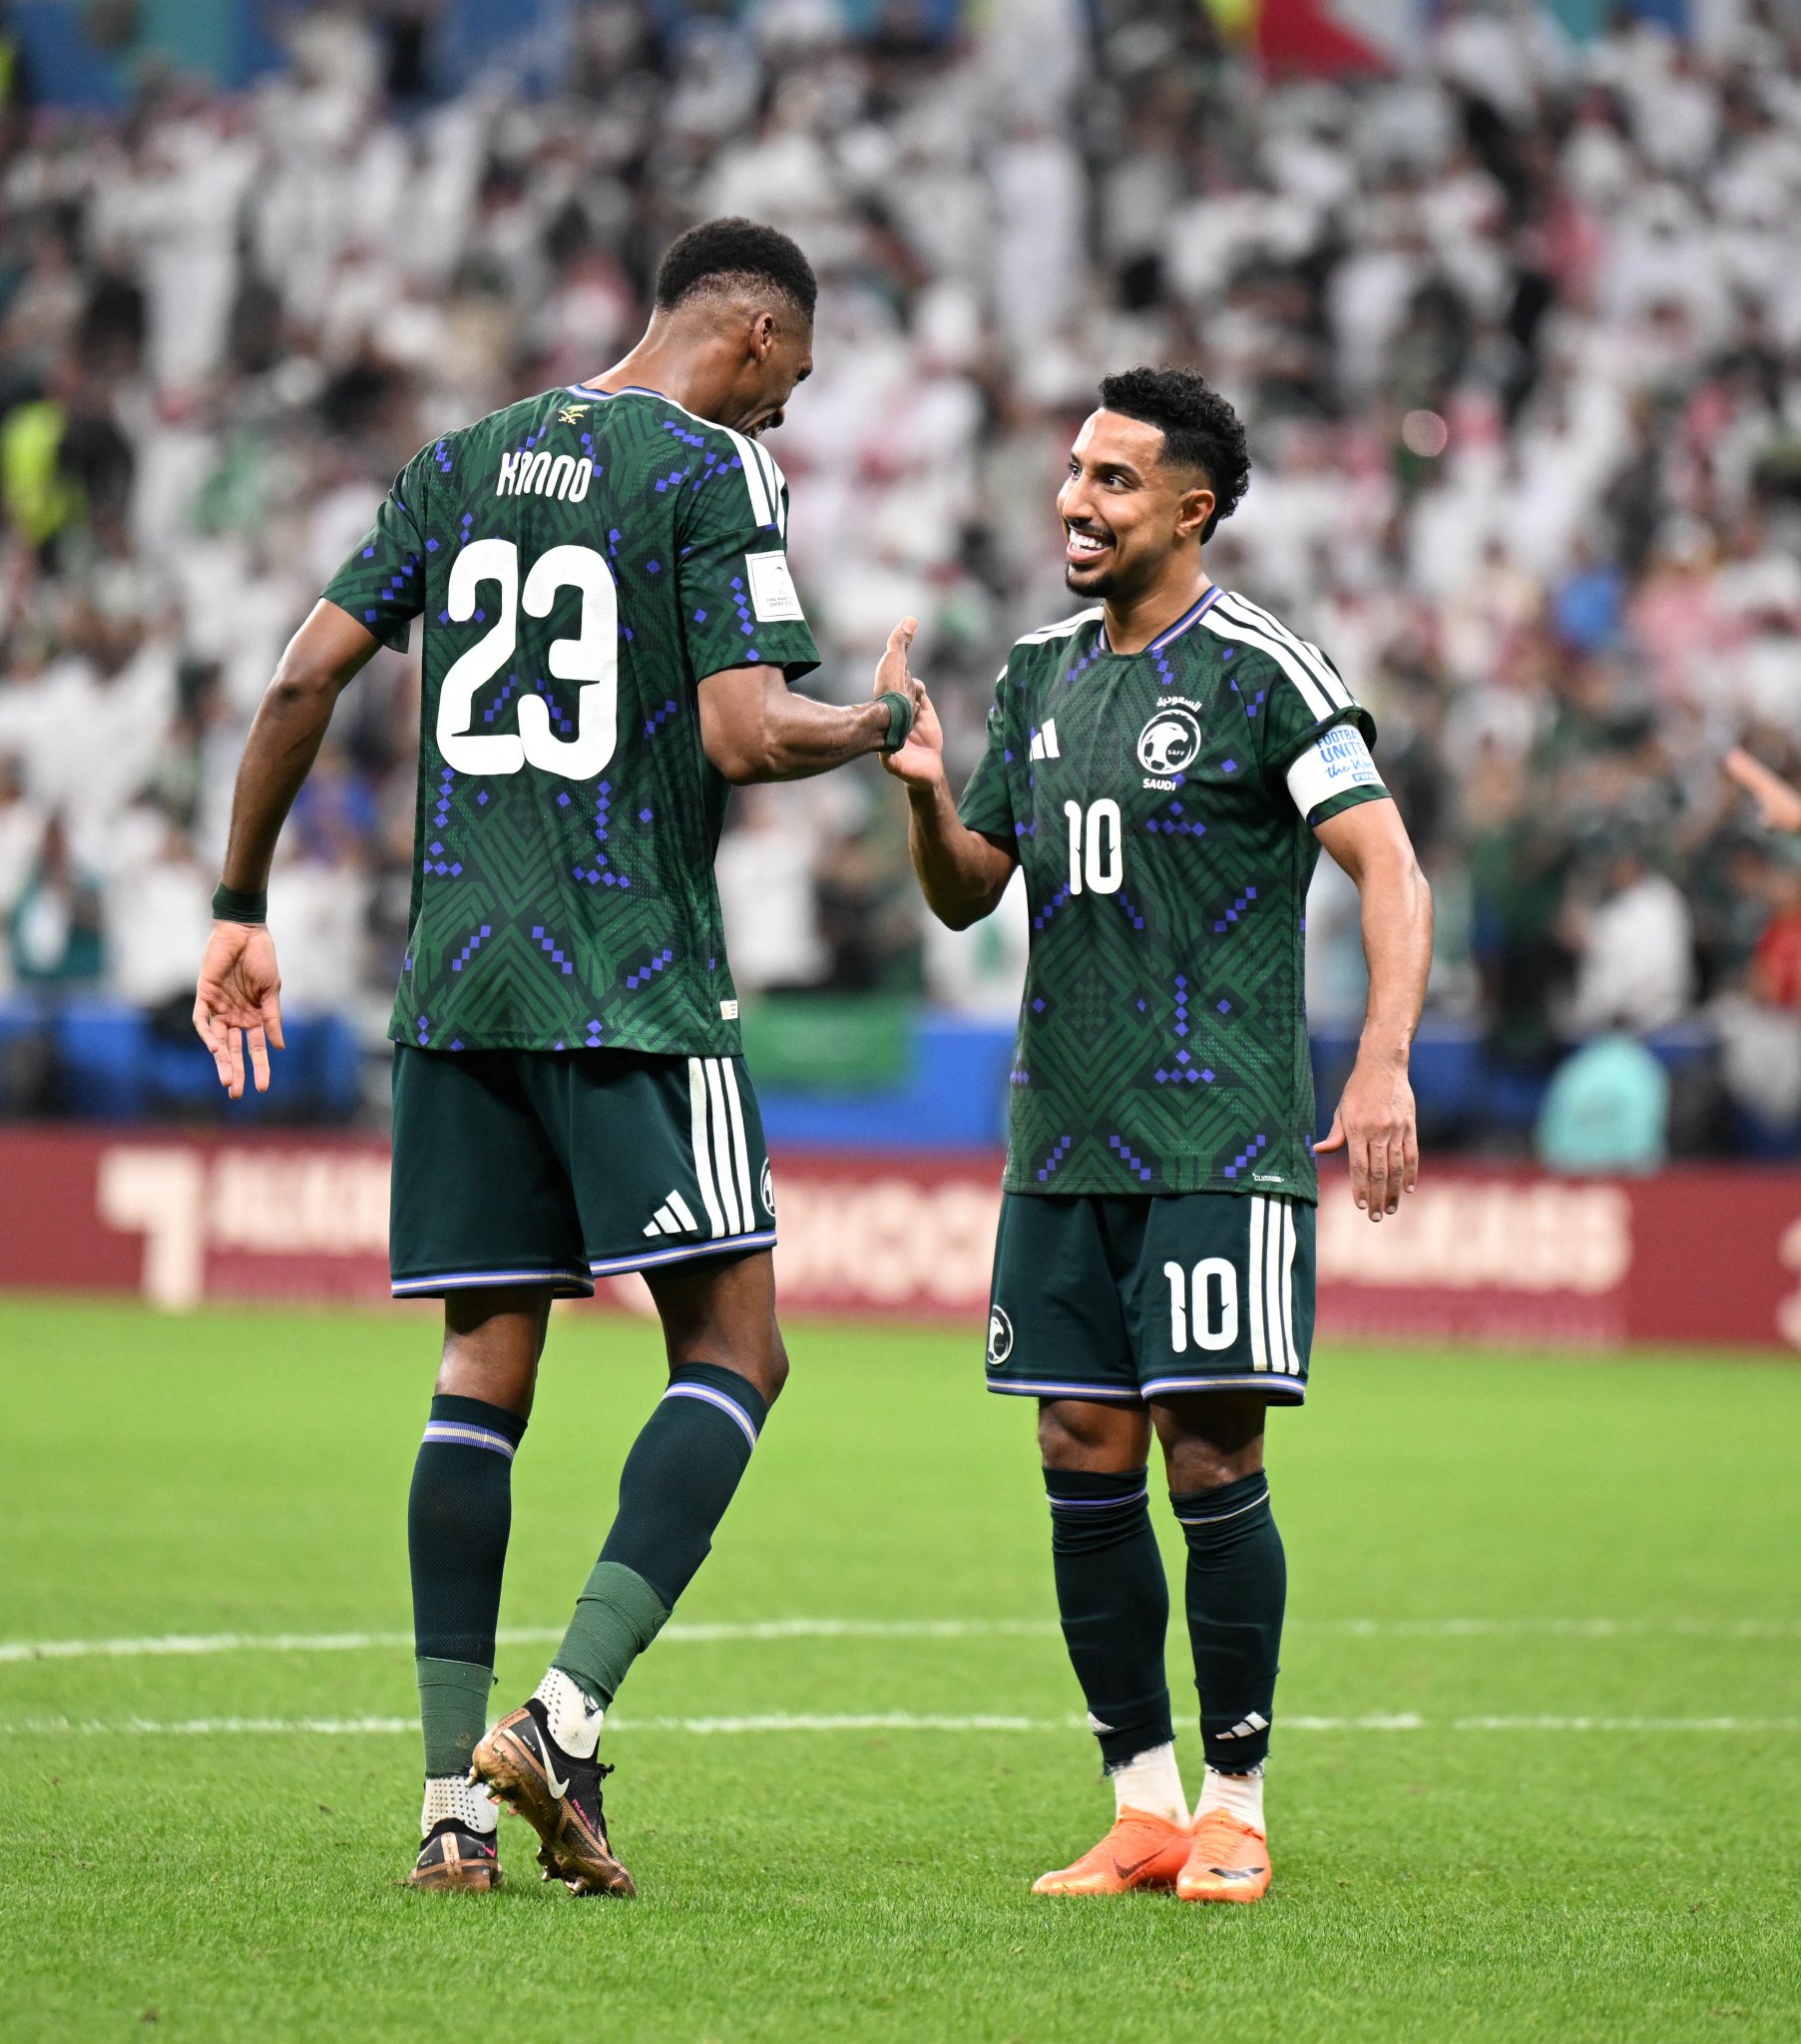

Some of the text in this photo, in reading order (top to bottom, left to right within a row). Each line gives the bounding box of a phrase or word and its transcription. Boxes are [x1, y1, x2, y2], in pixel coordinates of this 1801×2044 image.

[496, 451, 594, 503] KANNO
[436, 538, 618, 780] 23
[1156, 696, 1203, 713] السعودية
[1142, 777, 1177, 791] SAUDI
[1325, 763, 1351, 778] the
[1064, 798, 1124, 895] 10
[1163, 1258, 1238, 1352] 10
